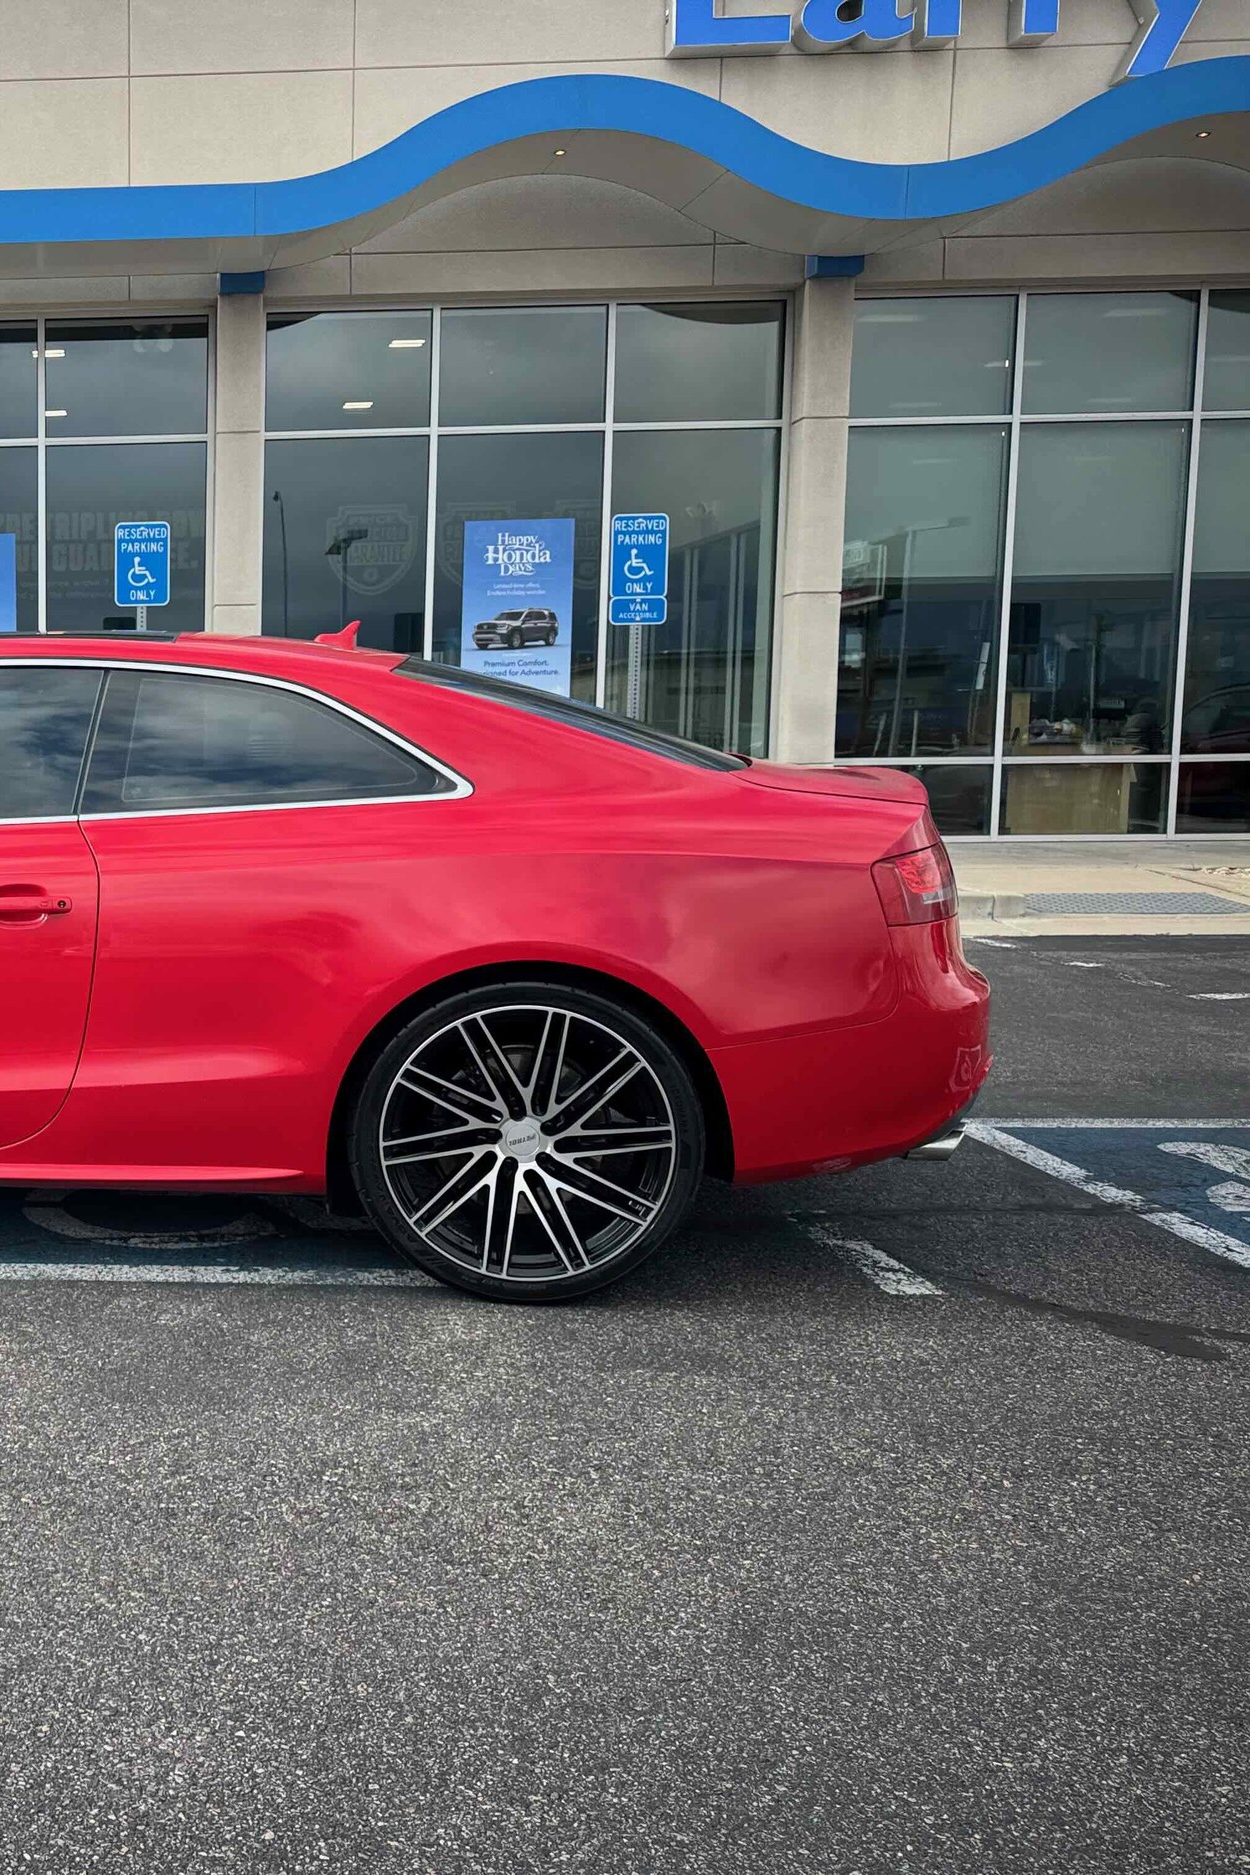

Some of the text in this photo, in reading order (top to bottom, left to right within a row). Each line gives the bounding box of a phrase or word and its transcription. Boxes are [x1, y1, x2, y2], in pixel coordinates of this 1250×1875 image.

[615, 519, 666, 531] RESERVED
[118, 527, 167, 539] RESERVED
[617, 533, 663, 545] PARKING
[121, 541, 164, 553] PARKING
[497, 532, 538, 550] Happy
[483, 541, 552, 565] Honda
[499, 563, 536, 576] Days
[625, 582, 653, 593] ONLY
[130, 589, 155, 600] ONLY
[629, 603, 648, 611] VAN
